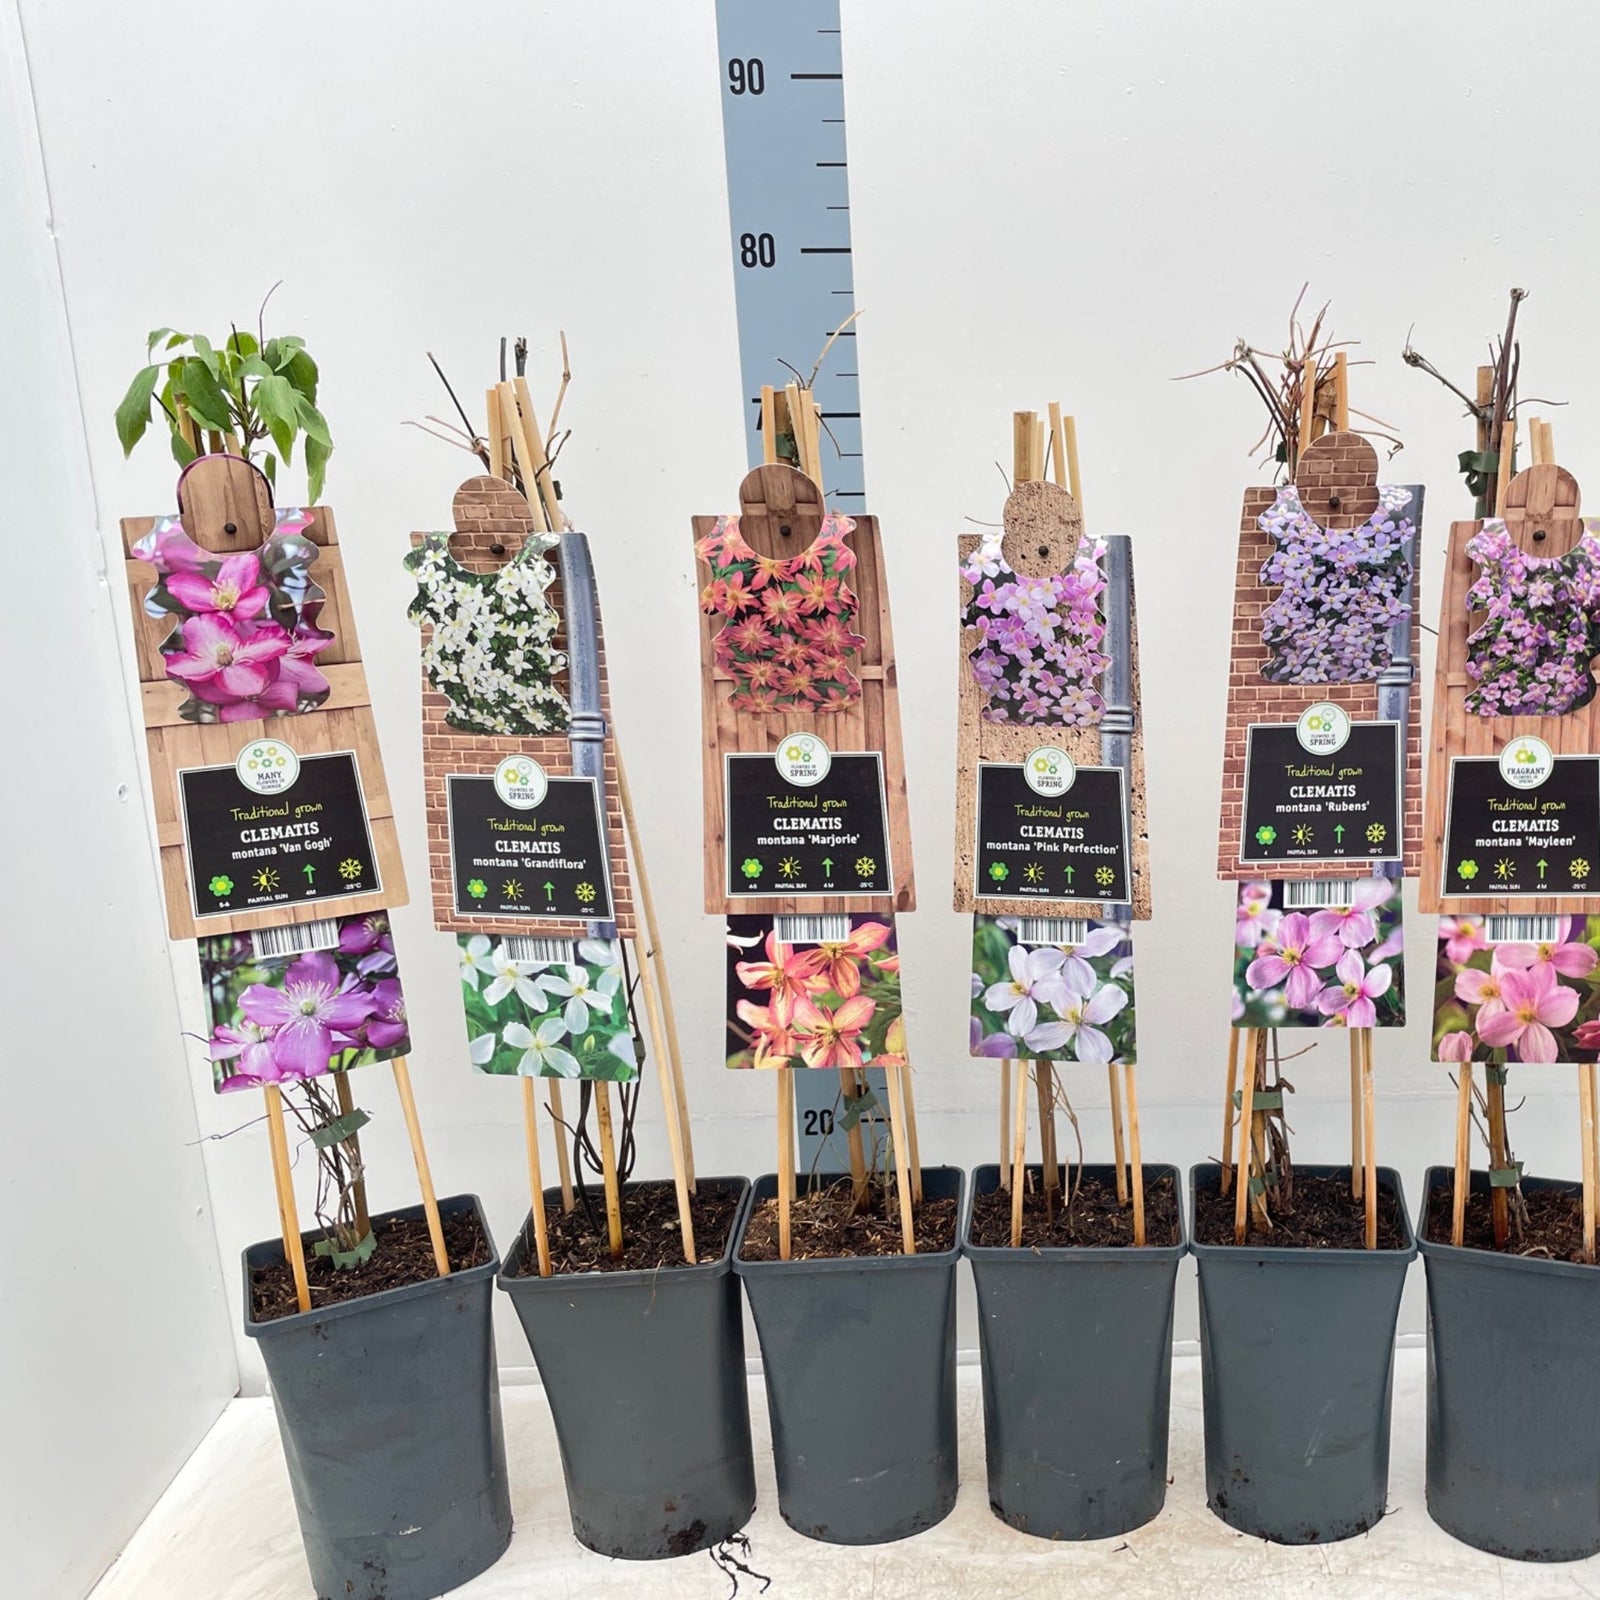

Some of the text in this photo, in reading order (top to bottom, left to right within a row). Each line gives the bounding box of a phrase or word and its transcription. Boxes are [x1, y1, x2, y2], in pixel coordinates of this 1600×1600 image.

[728, 58, 765, 95] 90
[740, 232, 776, 268] 80
[257, 771, 282, 780] MANY
[1285, 763, 1363, 780] Traditional grown
[1507, 767, 1545, 776] FRAGRANT
[1037, 780, 1062, 788] SPRING
[508, 792, 535, 800] SPRING
[1290, 785, 1356, 798] CLEMATIS
[767, 795, 847, 812] Traditional grown
[1276, 801, 1369, 813] montana 'Rubens'
[1488, 797, 1566, 814] Traditional grown
[230, 801, 323, 822] Traditional grown
[1015, 805, 1089, 822] Traditional grown
[487, 818, 565, 836] Traditional grown
[774, 818, 842, 830] CLEMATIS
[1492, 820, 1559, 832] CLEMATIS
[241, 822, 319, 843] CLEMATIS
[1020, 826, 1084, 839] CLEMATIS
[495, 840, 561, 854] CLEMATIS
[757, 834, 860, 847] montana 'Marjorie'
[1476, 836, 1575, 848] montana 'Mayleen'
[232, 837, 332, 860] montana 'Van Gogh'
[986, 841, 1118, 854] montana 'Pink Perfection'
[473, 858, 586, 869] montana 'Grandiflora'
[248, 896, 274, 904] PARTIAL
[804, 1109, 834, 1136] 20
